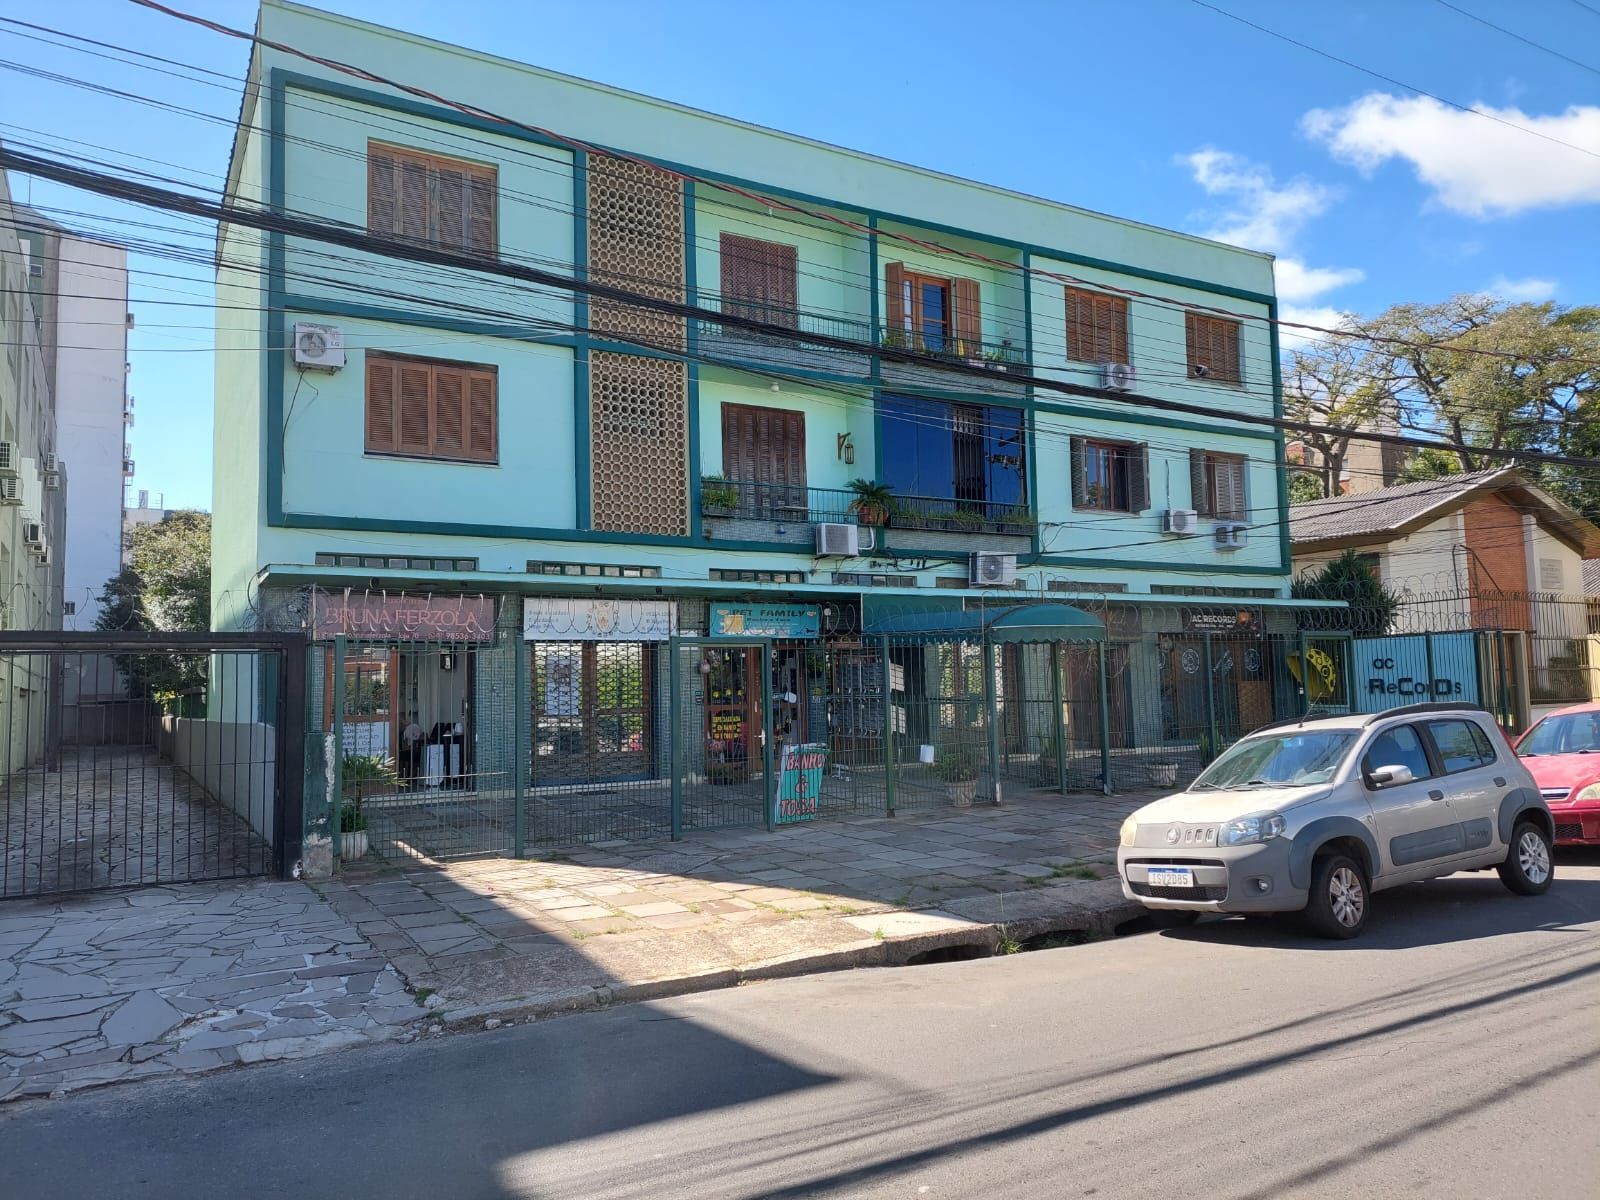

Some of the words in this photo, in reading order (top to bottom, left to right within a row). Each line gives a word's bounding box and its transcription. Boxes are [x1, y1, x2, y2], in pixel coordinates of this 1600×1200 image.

[326, 607, 392, 625] BRUNA
[395, 609, 478, 627] FERZOLA
[760, 609, 806, 617] FAMILY
[1368, 677, 1462, 696] ReCoDs
[787, 752, 825, 771] BANHO
